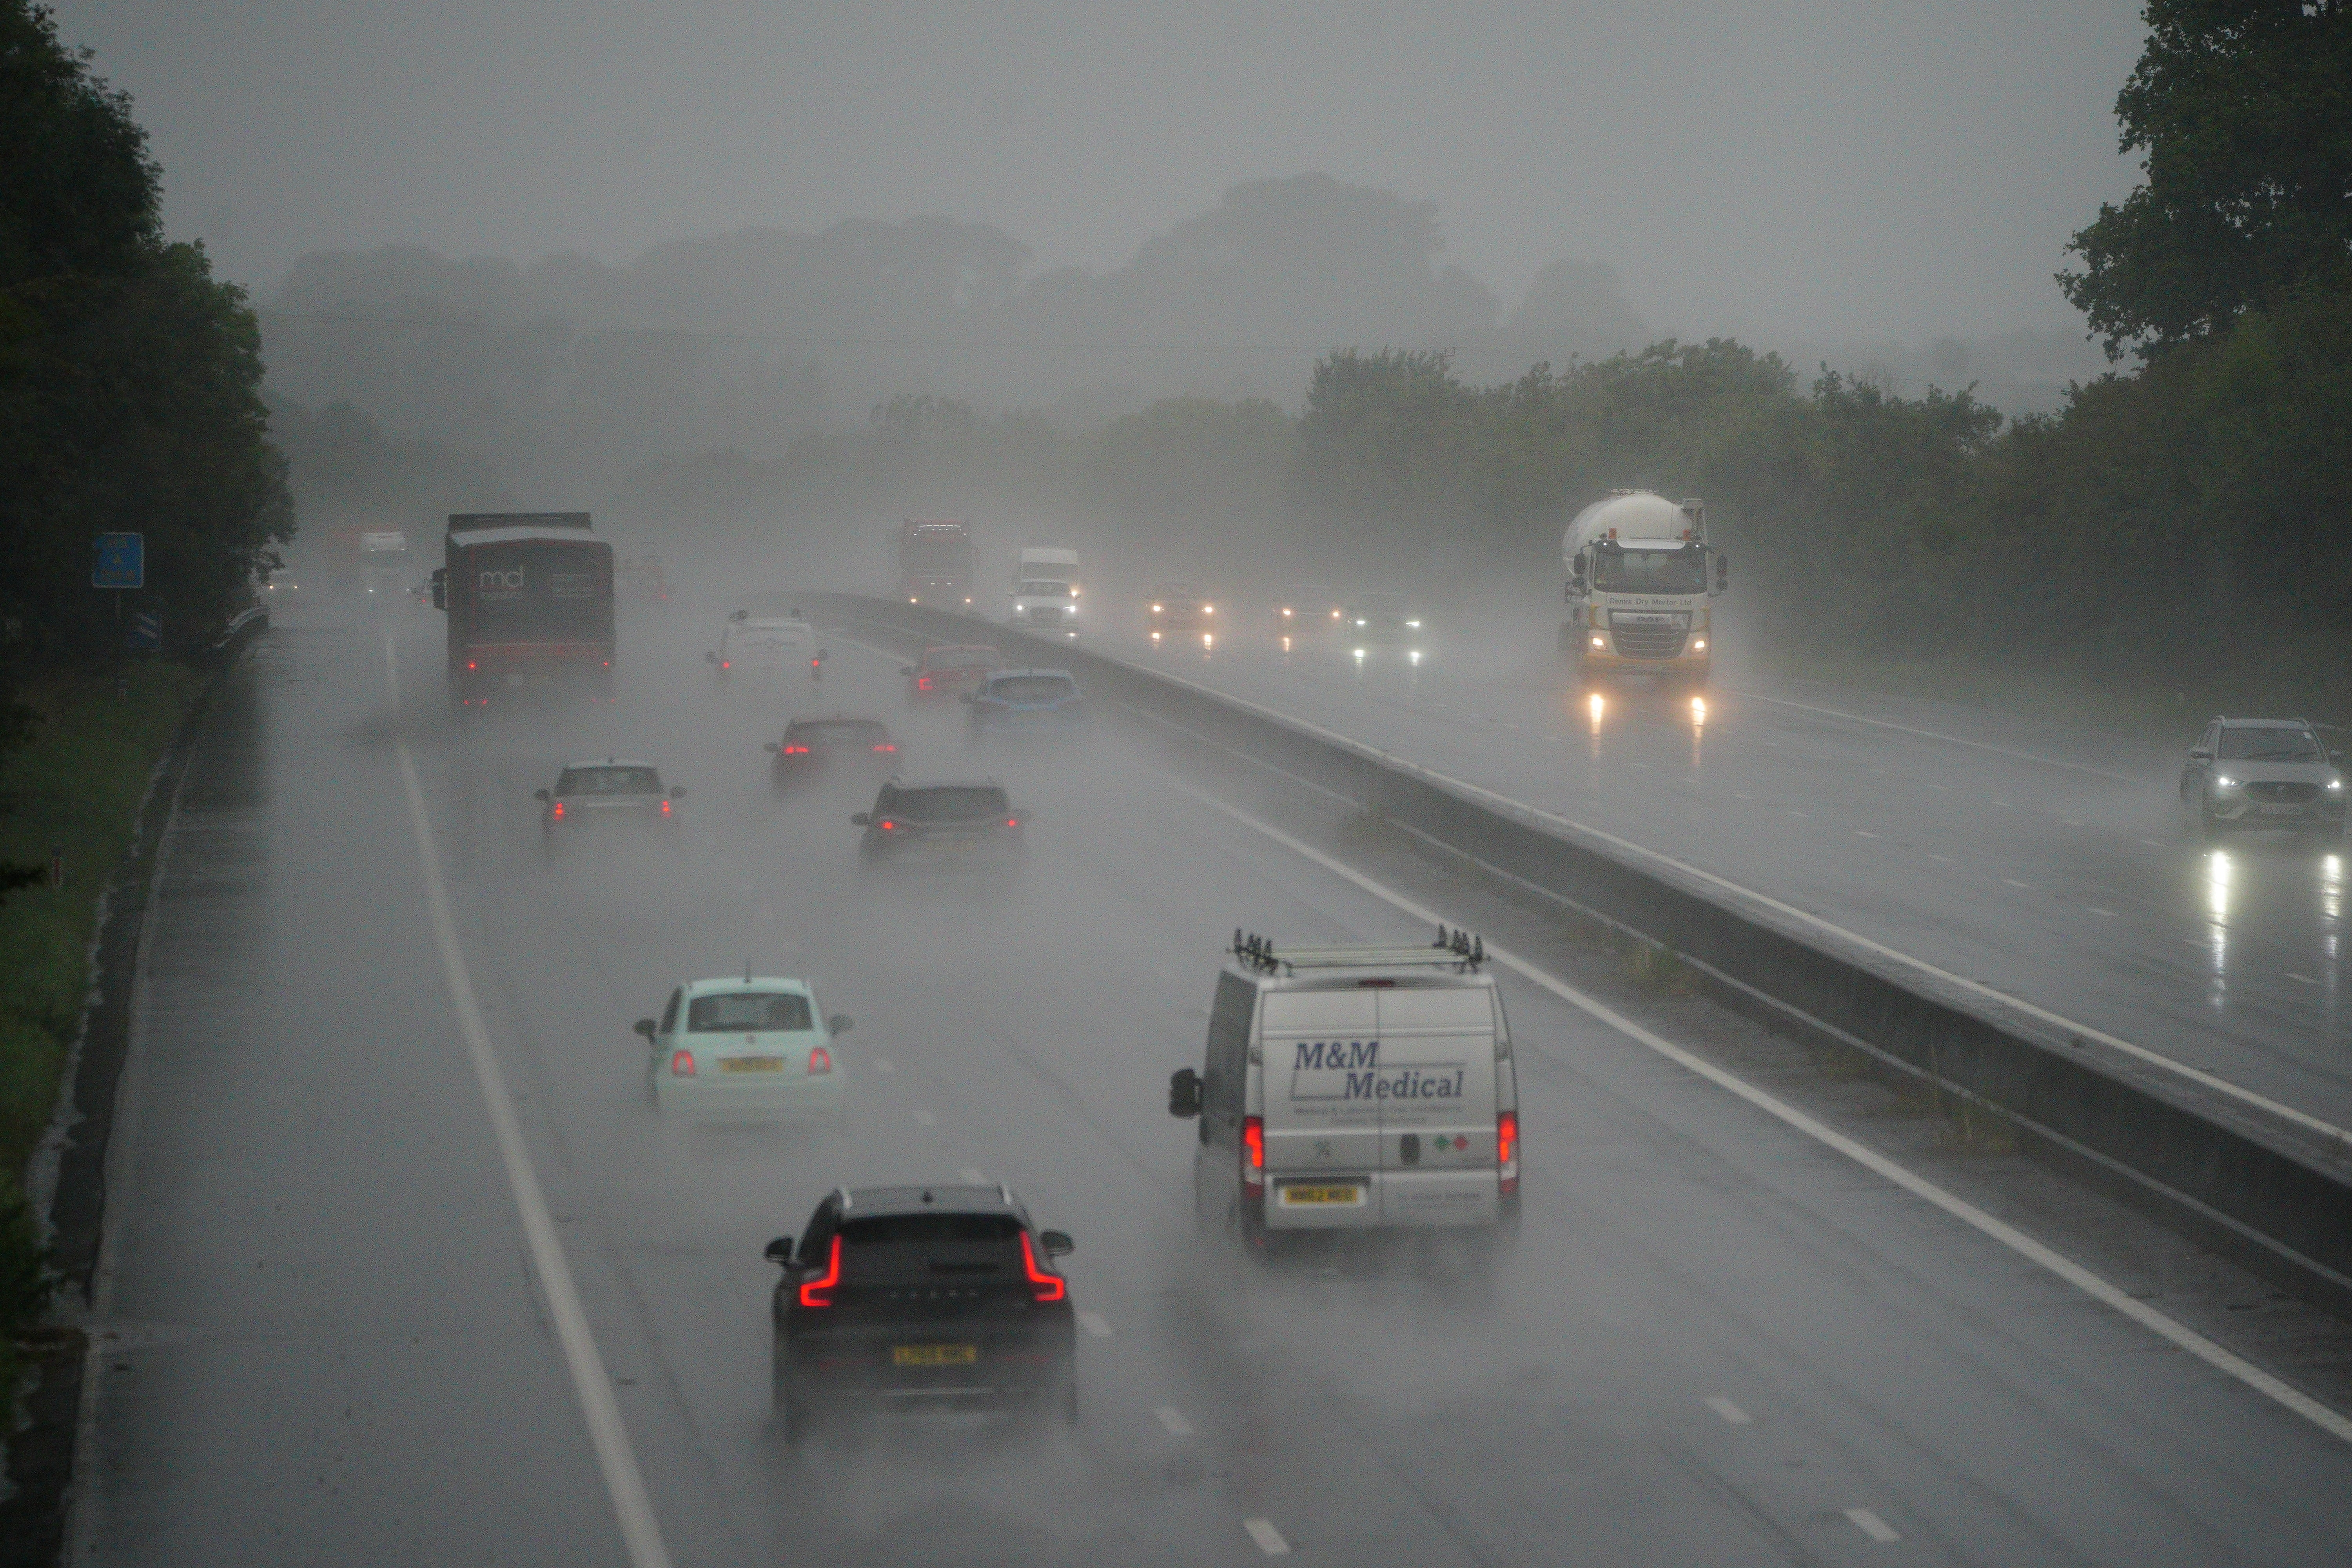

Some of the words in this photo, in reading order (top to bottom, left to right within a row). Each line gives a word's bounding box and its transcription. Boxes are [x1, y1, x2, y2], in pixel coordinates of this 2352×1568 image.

[480, 565, 524, 588] md
[1636, 598, 1649, 606] Dry
[1294, 1041, 1378, 1071] M&M
[1344, 1070, 1463, 1100] Medical
